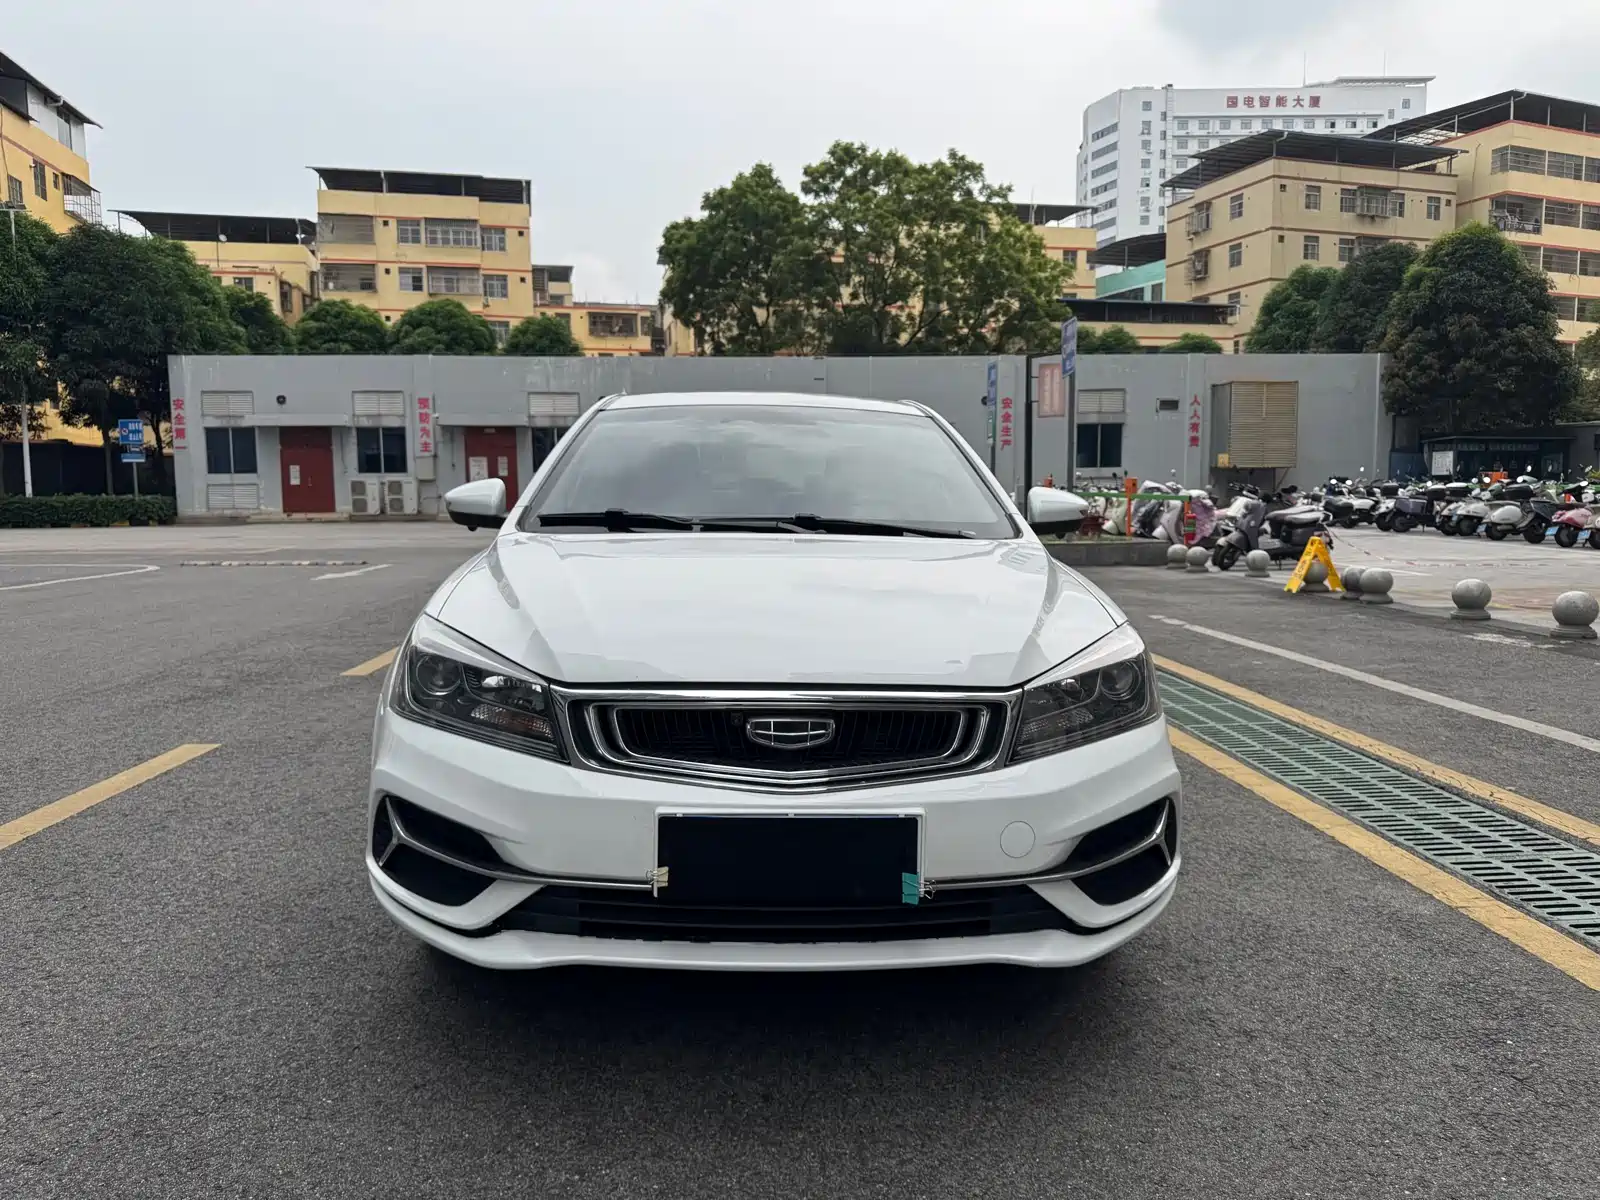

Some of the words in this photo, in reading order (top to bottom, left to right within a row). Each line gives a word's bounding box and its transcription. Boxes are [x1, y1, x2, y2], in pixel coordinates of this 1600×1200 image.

[1226, 95, 1321, 109] 国电智能大厦
[172, 398, 187, 450] 安全第一
[417, 397, 433, 453] 预防为主
[1001, 396, 1013, 451] 安全生产
